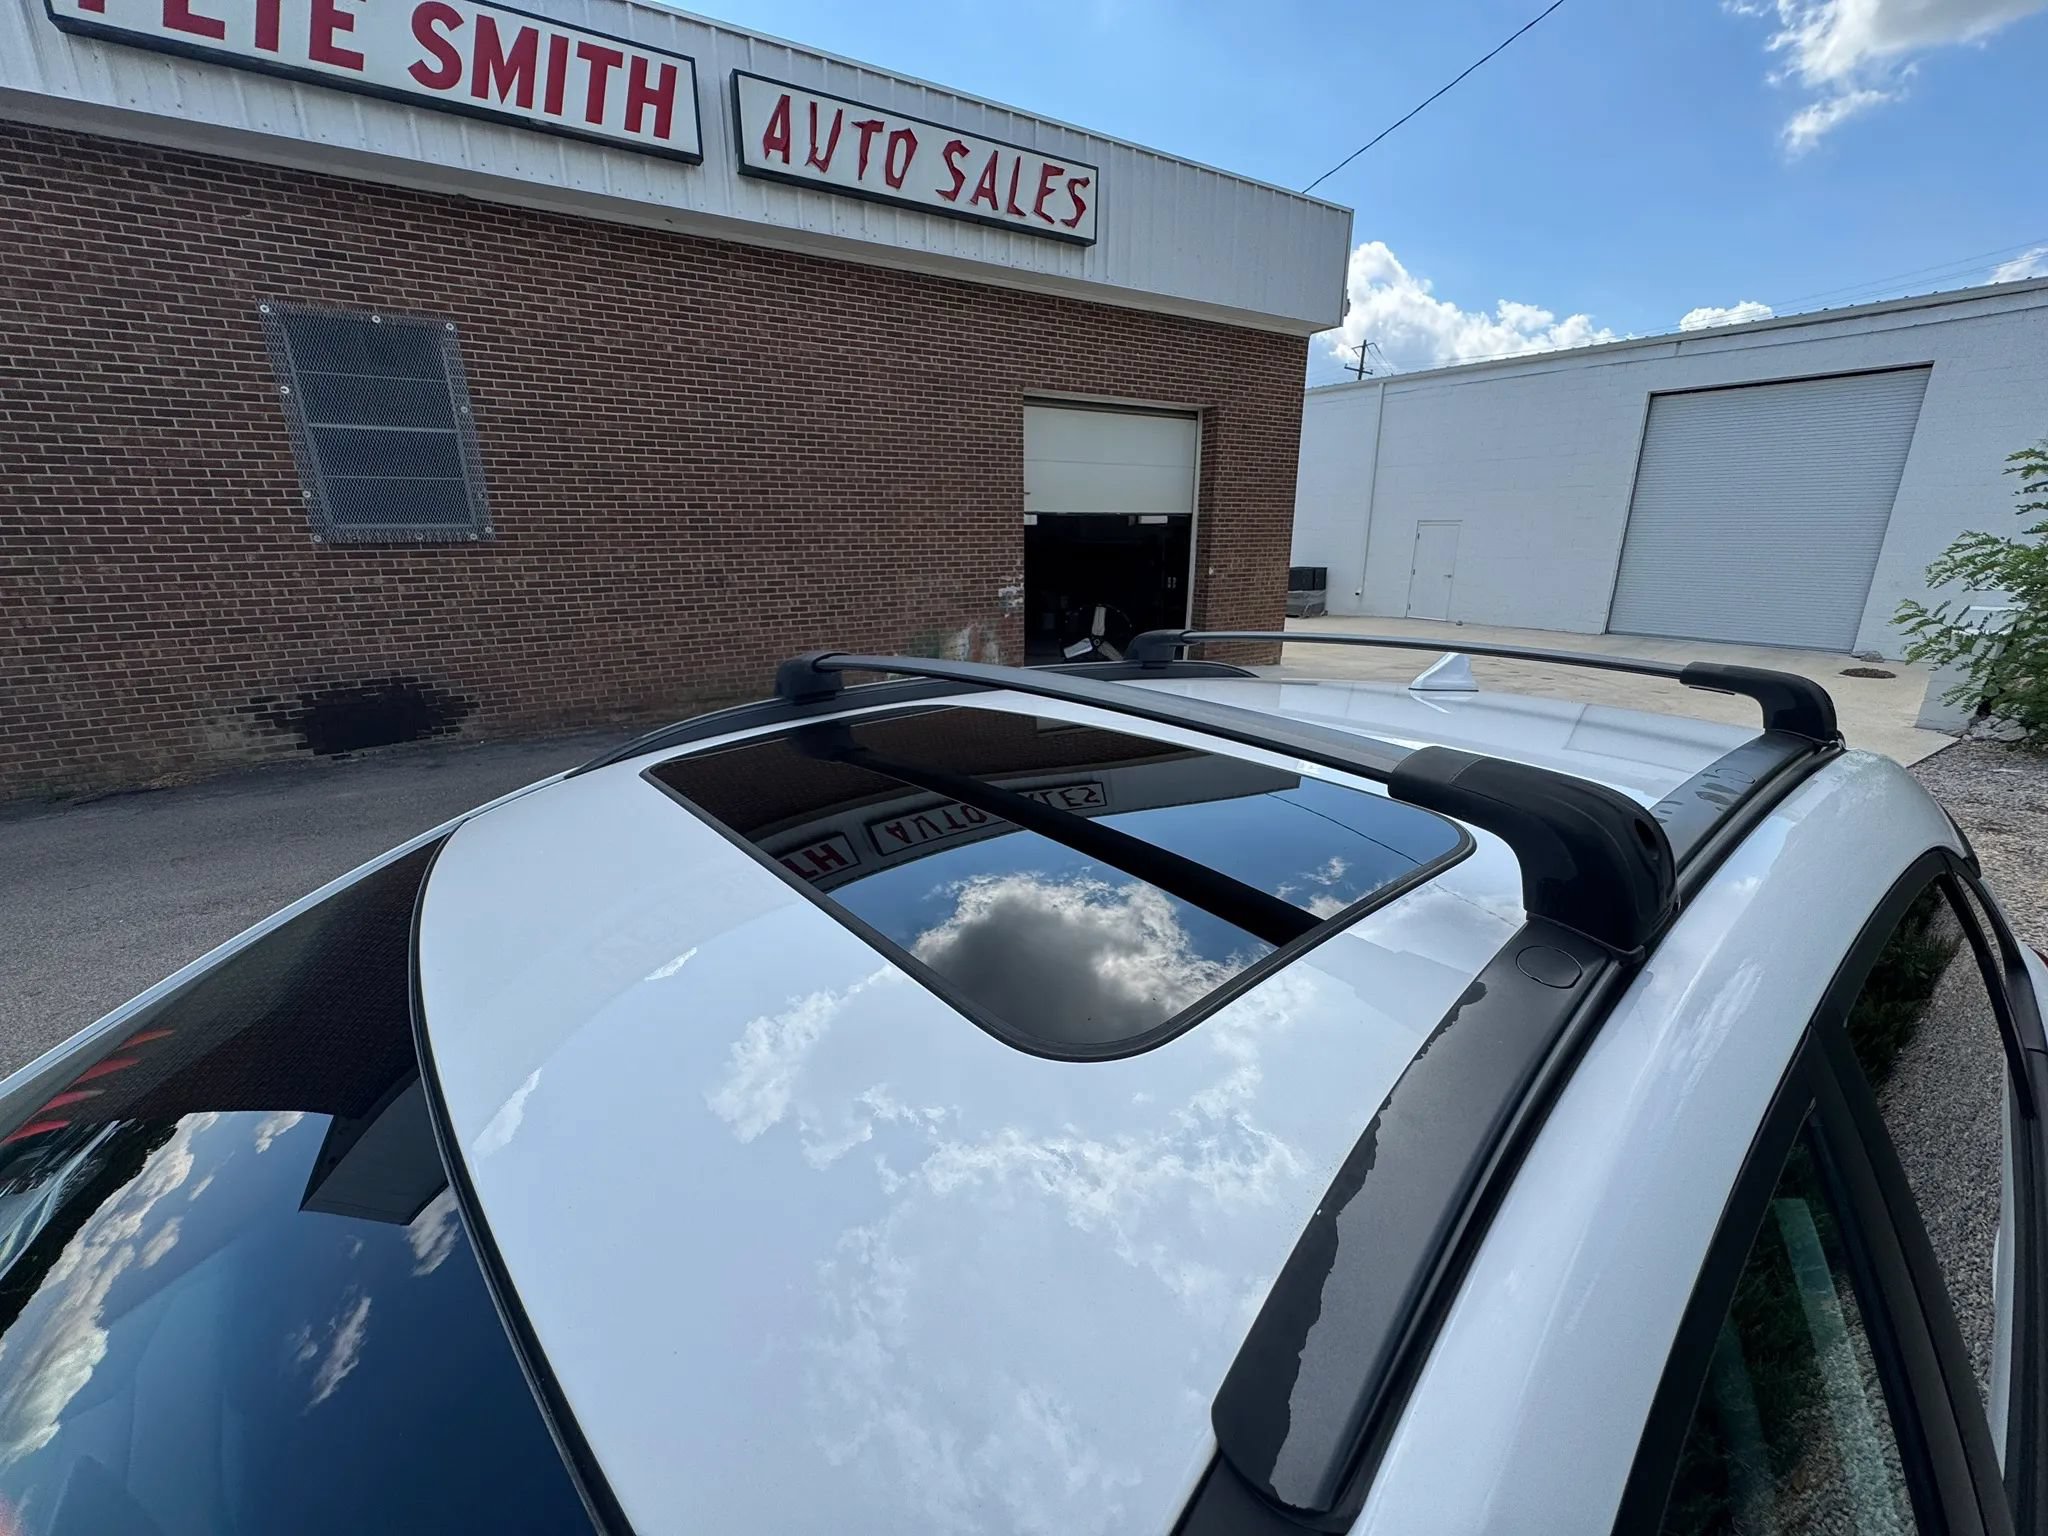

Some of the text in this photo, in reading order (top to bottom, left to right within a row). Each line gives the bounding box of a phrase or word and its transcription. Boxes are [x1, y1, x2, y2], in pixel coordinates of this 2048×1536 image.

[408, 1, 678, 140] SMITH
[762, 94, 1090, 228] AUTO SALES
